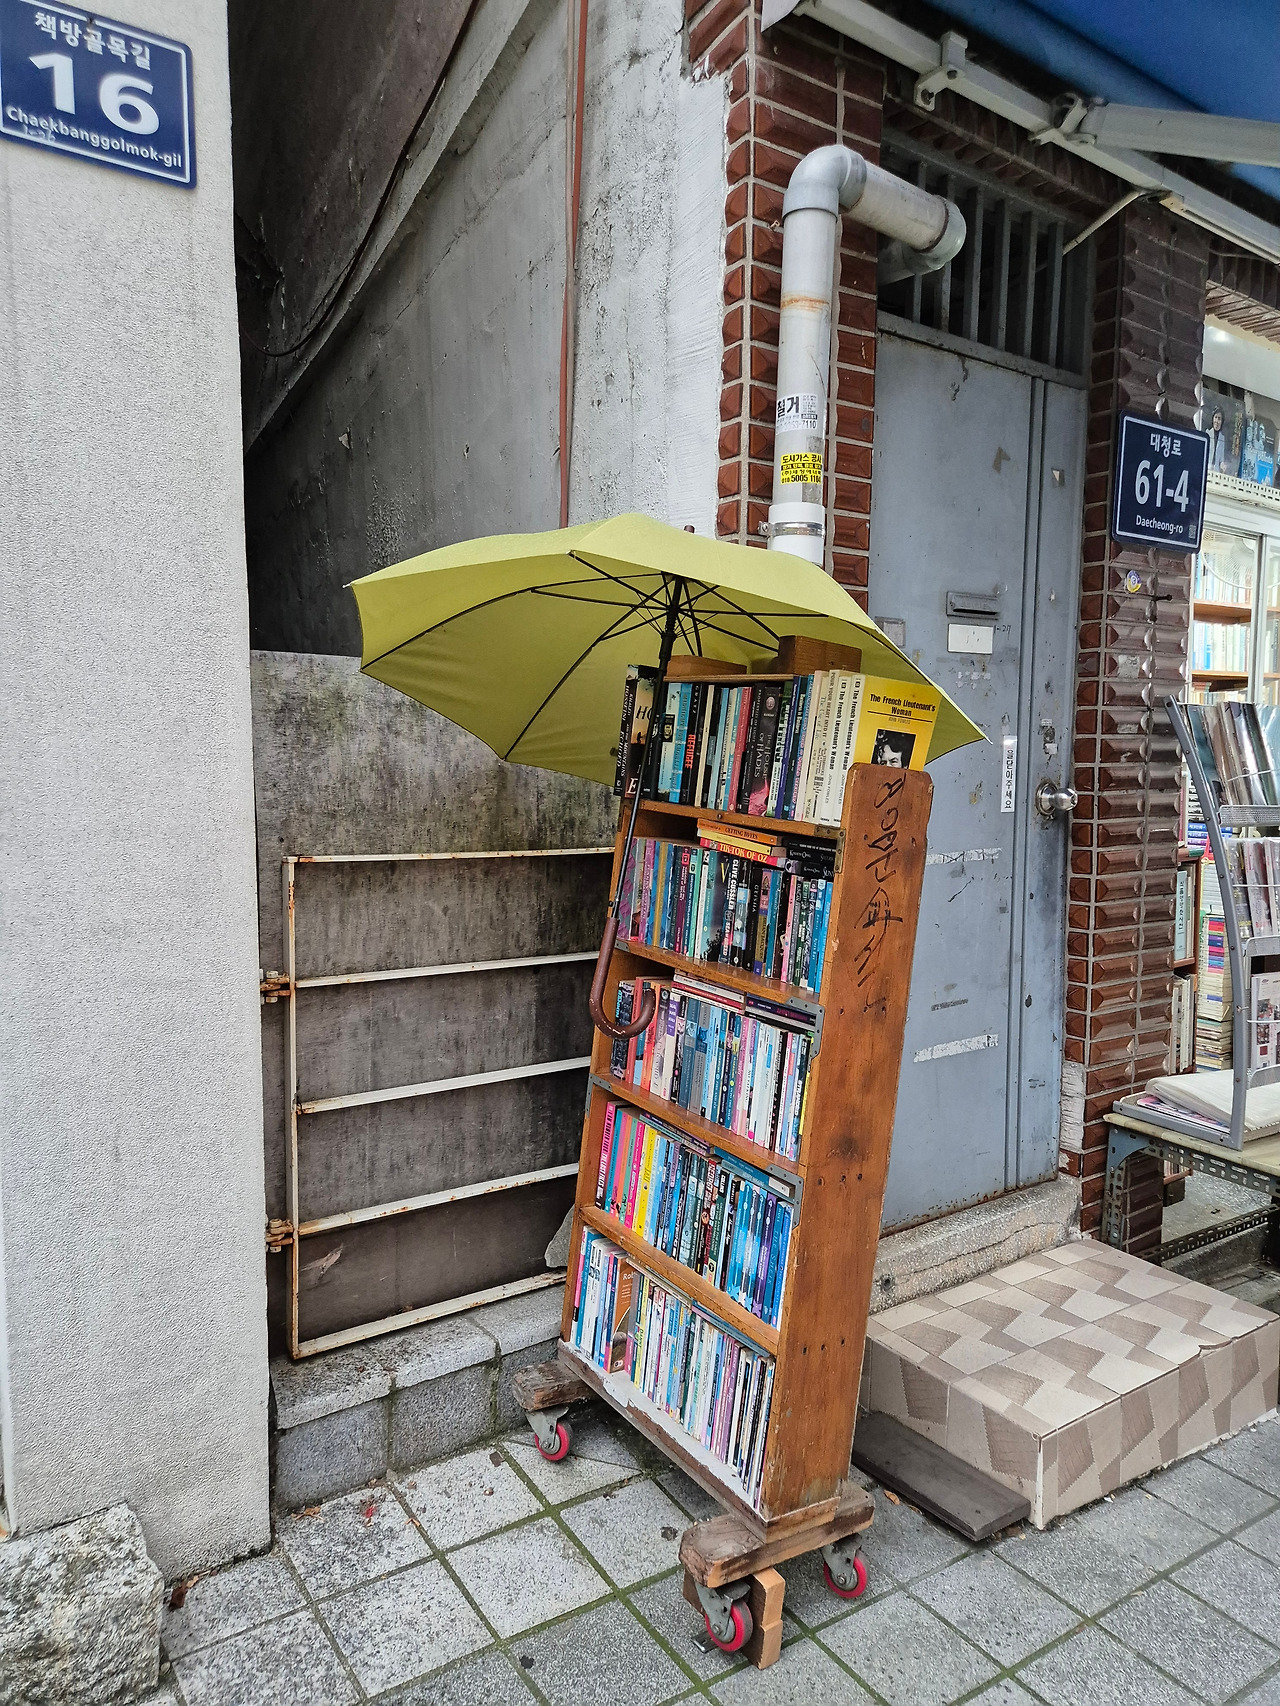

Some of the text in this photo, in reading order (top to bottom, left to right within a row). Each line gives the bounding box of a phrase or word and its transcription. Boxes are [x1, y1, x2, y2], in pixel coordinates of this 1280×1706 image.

[35, 11, 151, 70] 책방골목길
[29, 53, 160, 135] 16
[6, 104, 182, 168] Chaekbanggolmok-gil
[1150, 433, 1182, 458] 대청로
[791, 474, 809, 483] 5005
[1135, 459, 1189, 513] 61-4
[1136, 514, 1184, 534] Daecheong-ro
[836, 701, 844, 717] French
[849, 701, 857, 717] French
[870, 693, 936, 712] The French Lieutenant's
[891, 705, 912, 717] Woman
[831, 719, 841, 749] Lieutenant's
[845, 719, 855, 749] Lieutenant's
[684, 733, 696, 769] REFUGEE
[752, 743, 764, 777] HADES
[760, 746, 771, 779] HOUSE
[828, 750, 836, 769] Woman
[842, 751, 850, 770] Woman
[720, 842, 746, 858] TIK-TOK
[757, 852, 768, 864] OZ
[727, 858, 740, 910] CLIVE CUSSLER
[750, 883, 759, 913] GEISHA
